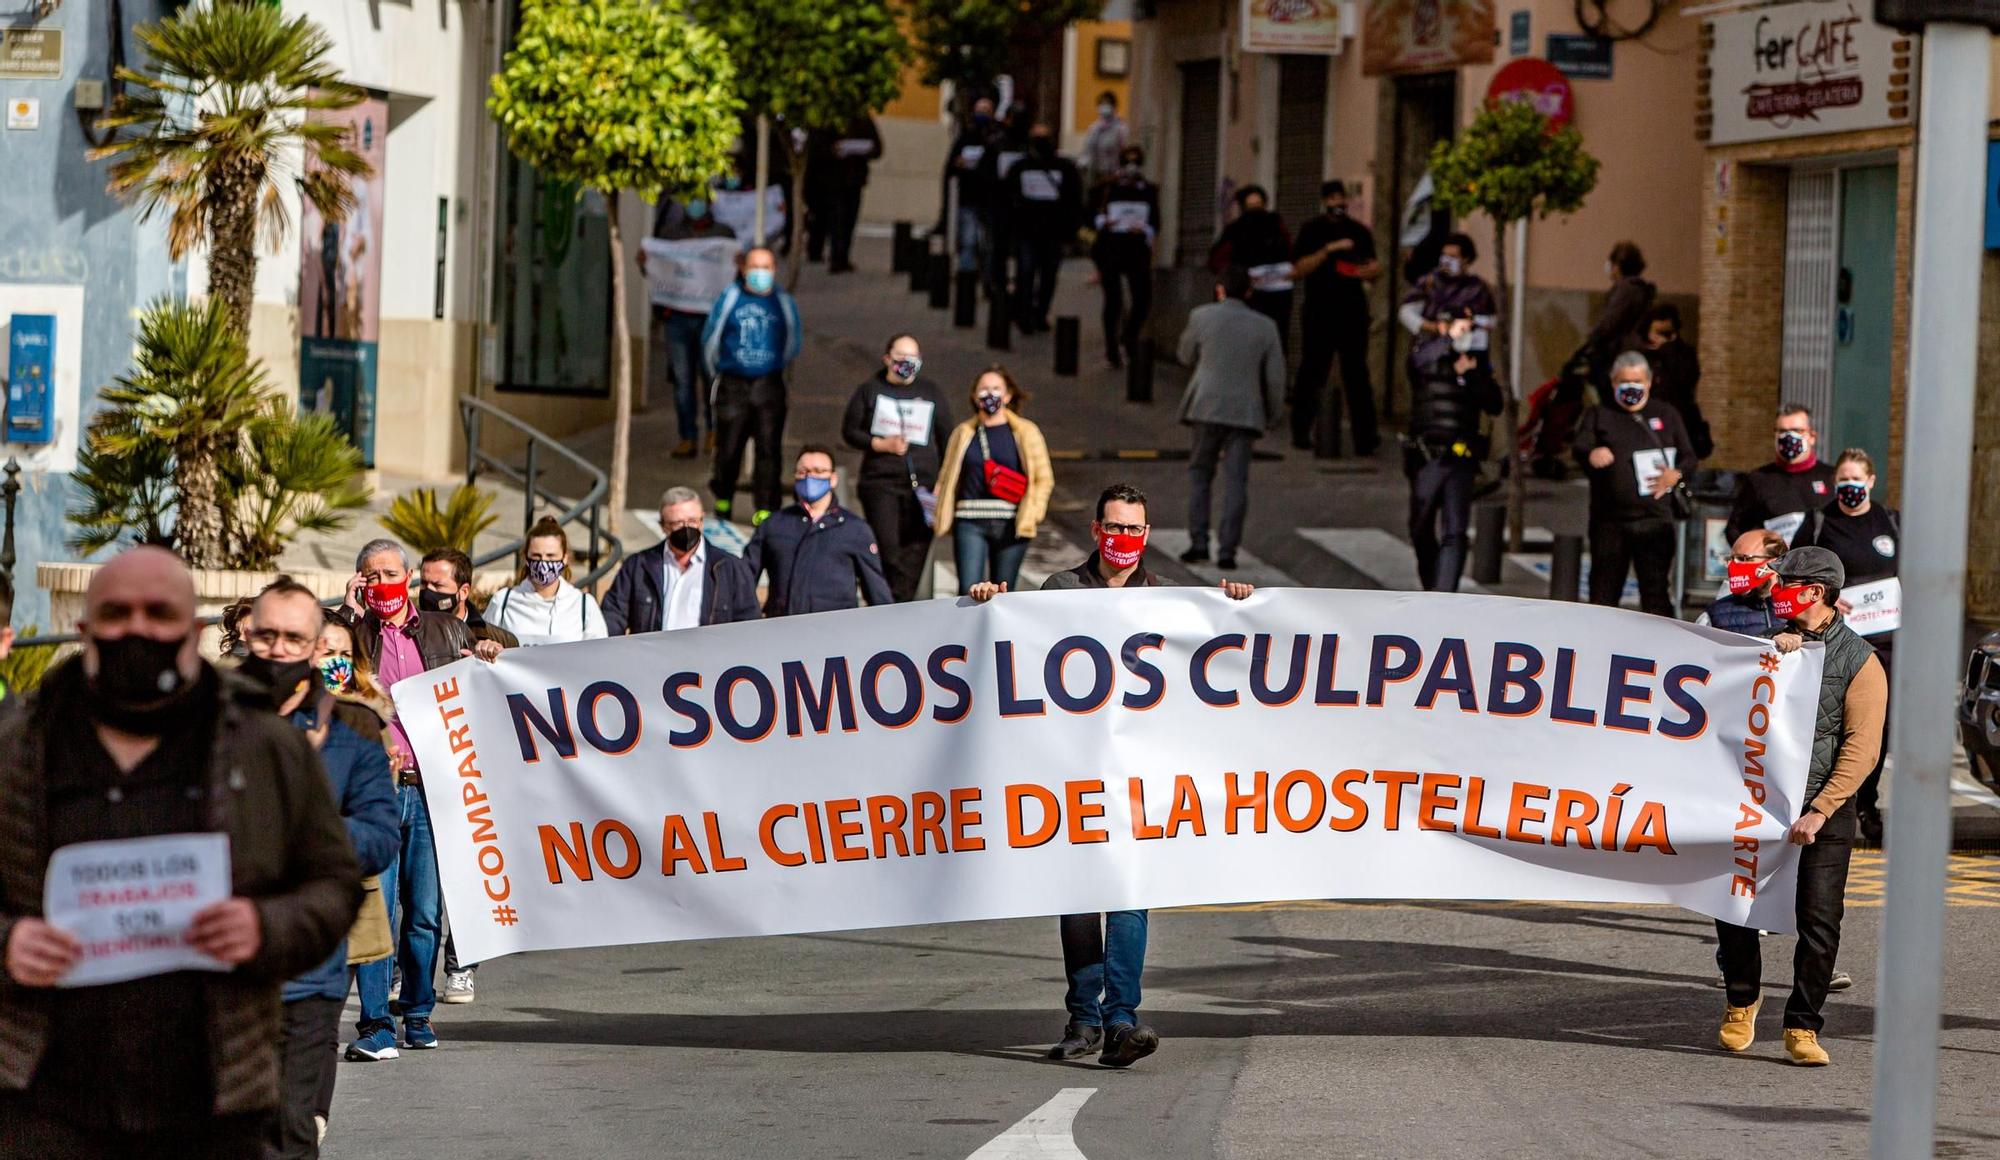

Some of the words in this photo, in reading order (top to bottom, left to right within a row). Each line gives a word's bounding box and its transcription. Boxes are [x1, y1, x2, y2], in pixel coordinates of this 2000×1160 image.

[1863, 590, 1884, 604] SOS
[506, 681, 642, 764] NO
[662, 645, 971, 749] SOMOS
[995, 633, 1165, 718] LOS
[1190, 634, 1711, 741] CULPABLES
[433, 677, 518, 926] #COMPARTE
[538, 820, 641, 884] NO
[662, 811, 747, 876] AL
[759, 788, 985, 867] CIERRE
[1005, 779, 1109, 848] DE
[1128, 775, 1206, 840] LA
[1224, 769, 1677, 855] HOSTELERÍA
[1731, 652, 1781, 898] #COMPARTE
